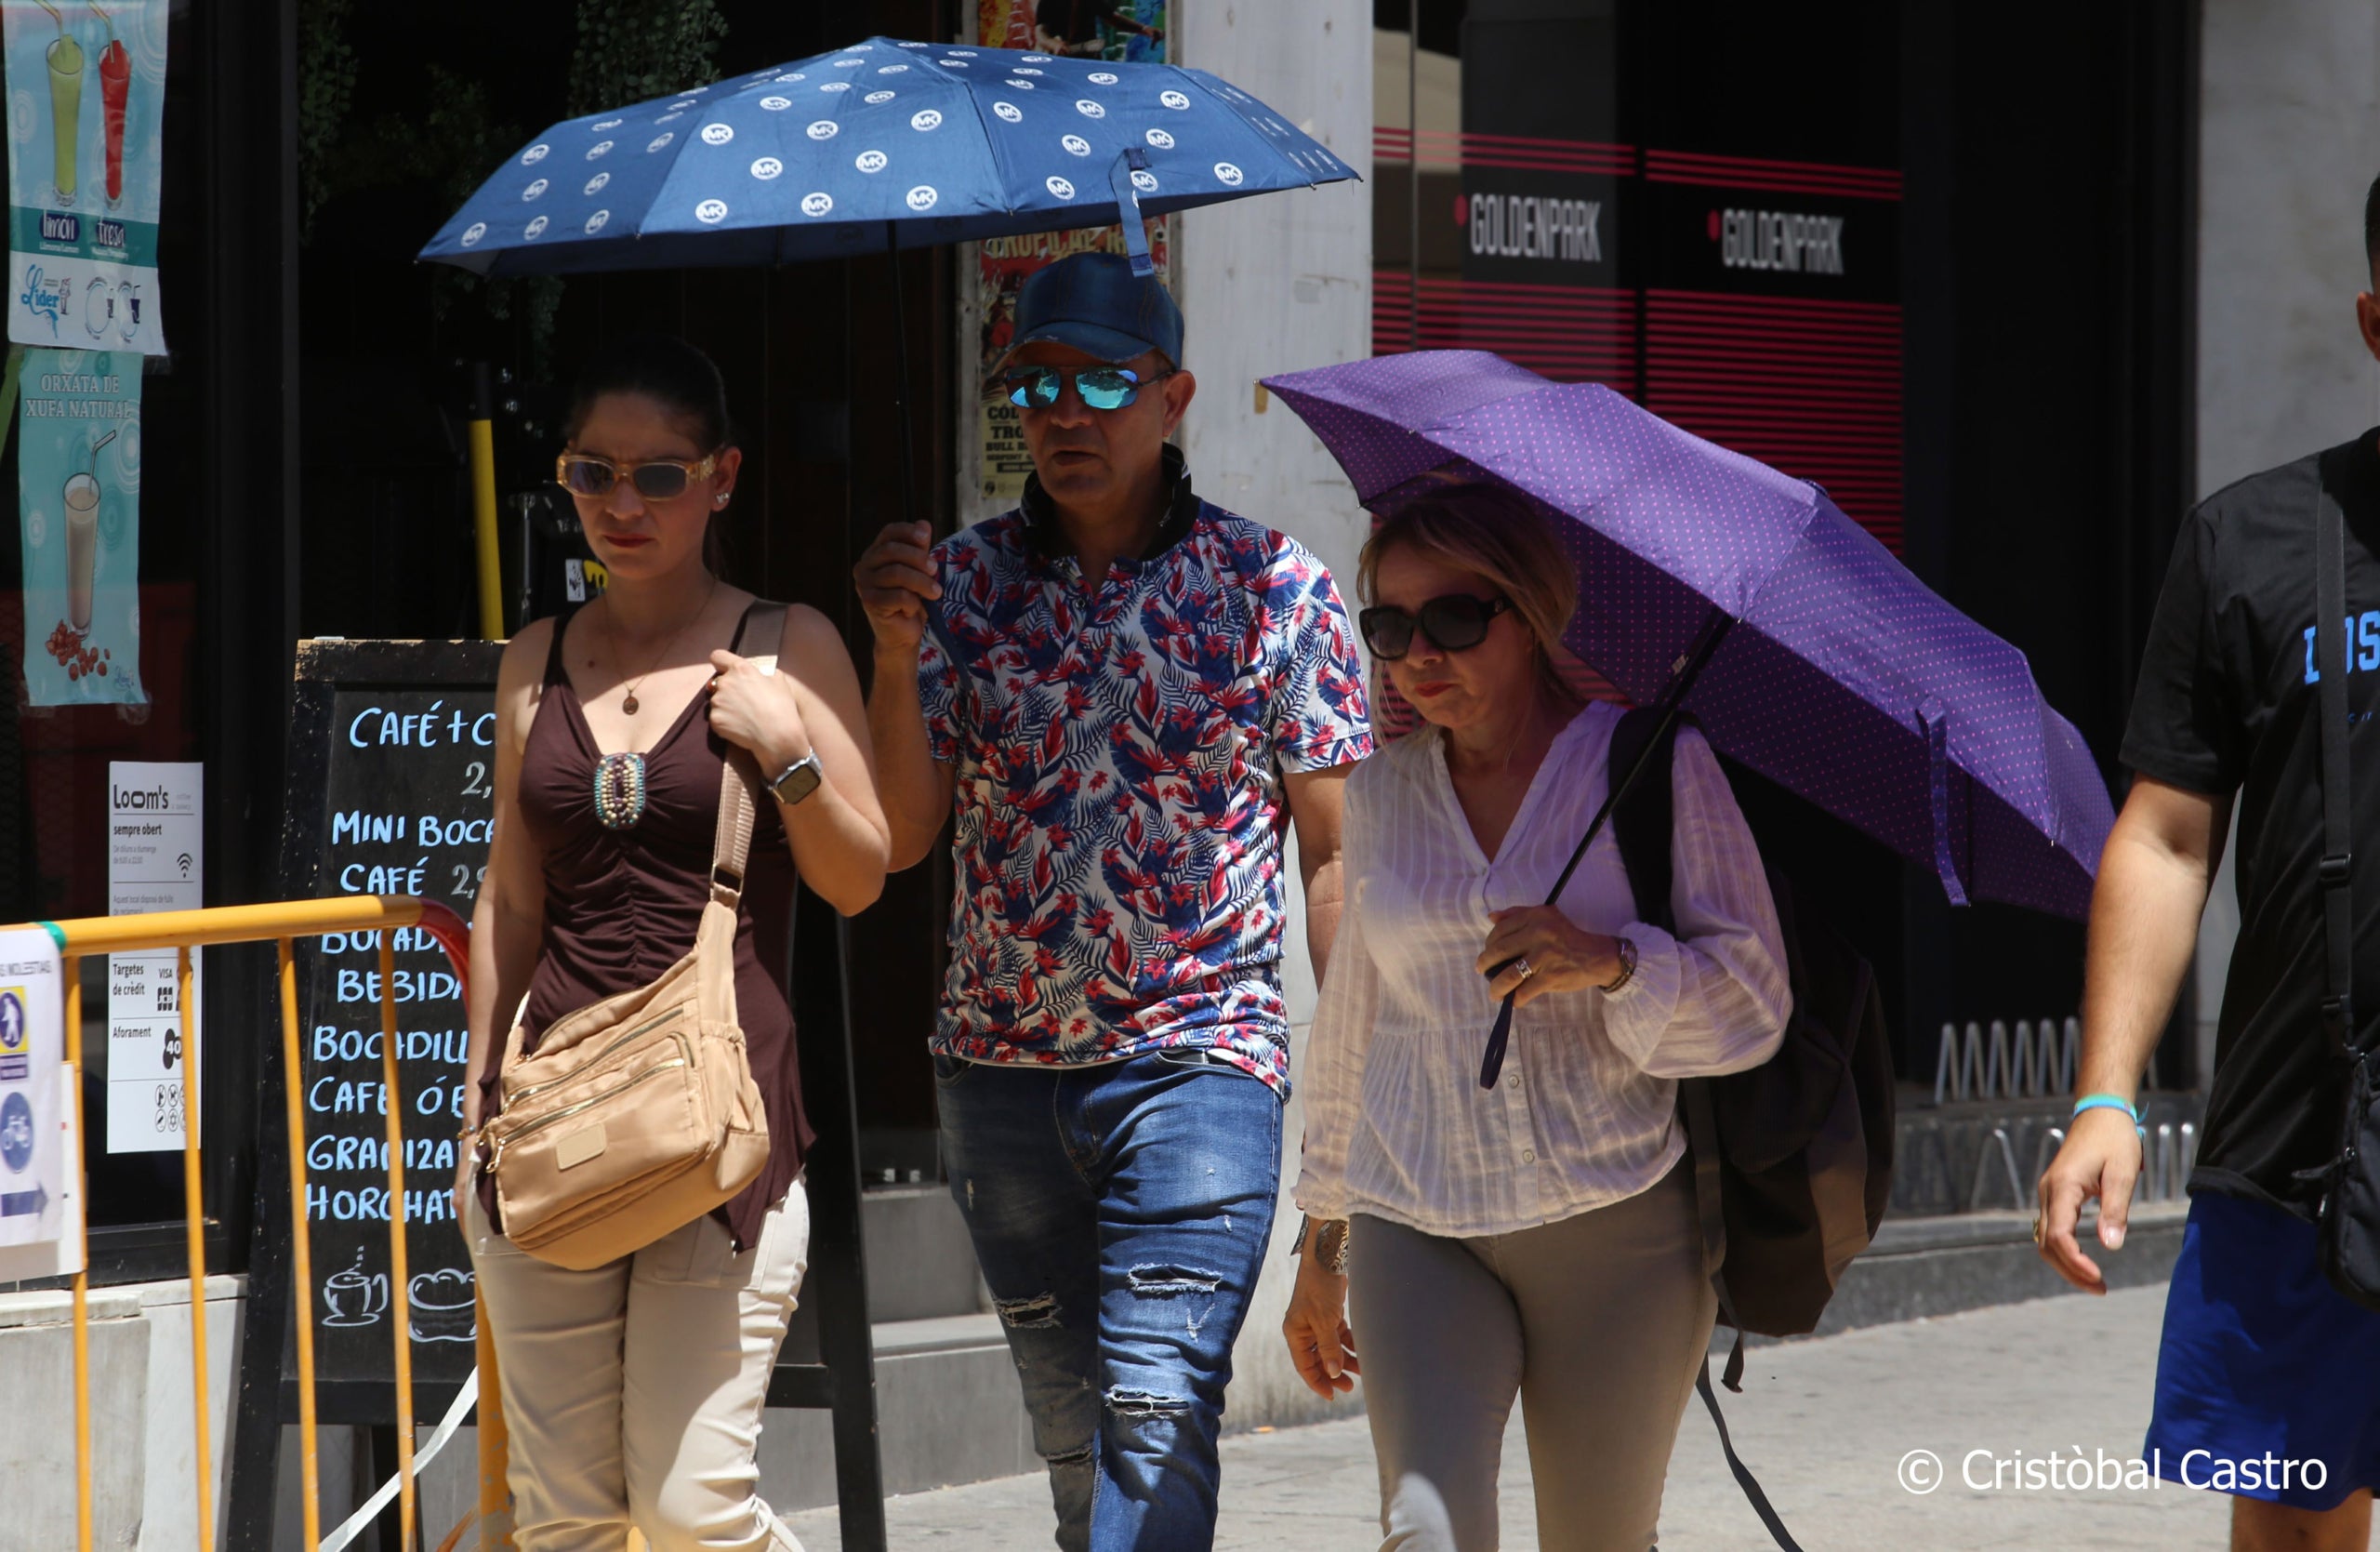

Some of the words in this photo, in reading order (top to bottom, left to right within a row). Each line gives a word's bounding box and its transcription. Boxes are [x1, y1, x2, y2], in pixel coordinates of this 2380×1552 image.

[1470, 192, 1602, 262] GOLDENPARK
[1722, 207, 1844, 275] GOLDENPARK
[41, 374, 99, 392] ORXATA
[103, 375, 120, 393] DE
[25, 399, 65, 417] XUFA
[69, 400, 131, 418] NATURAL
[113, 784, 168, 809] Loom's
[113, 825, 142, 837] sempre
[142, 823, 162, 835] obert
[332, 810, 404, 845] MINI
[339, 856, 429, 895] CAFÉ
[321, 927, 446, 954] BOAD
[112, 963, 144, 978] Targetes
[159, 968, 173, 978] VISA
[112, 984, 122, 995] de
[124, 981, 145, 995] crèdit
[112, 1026, 152, 1039] Aforament
